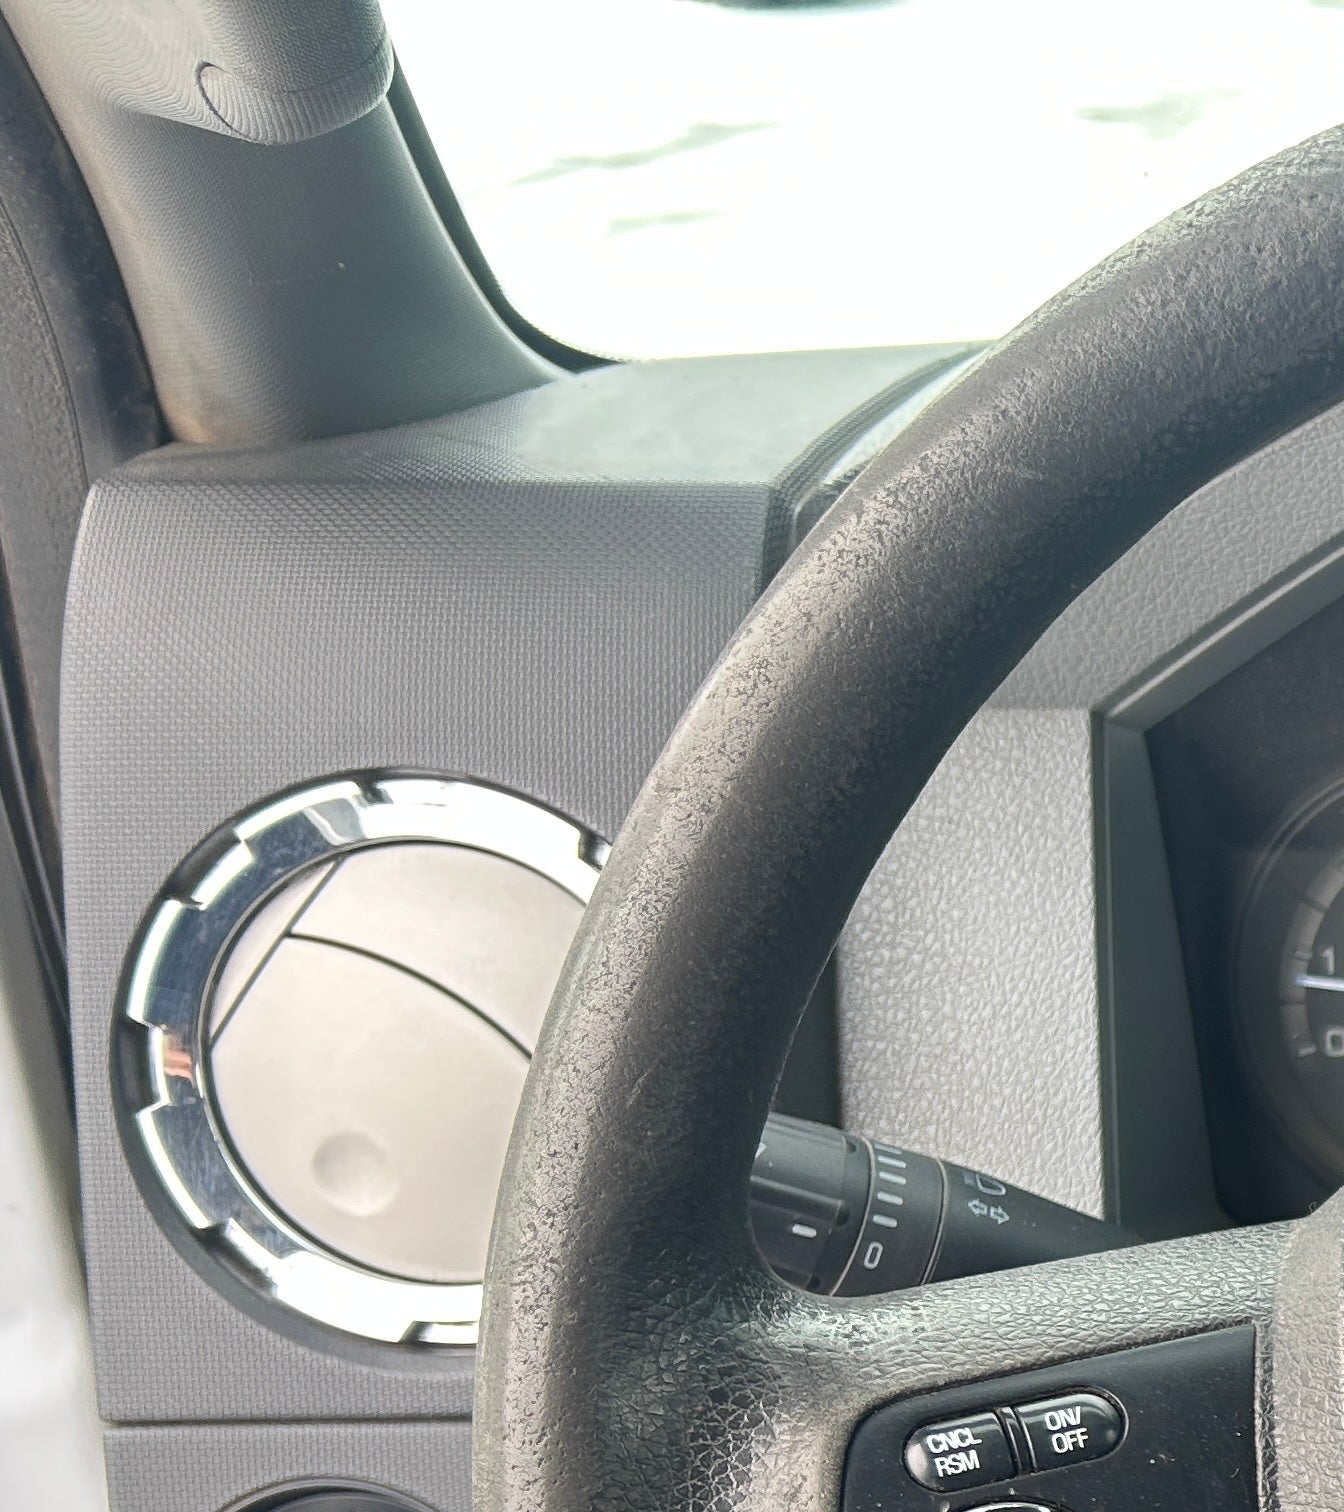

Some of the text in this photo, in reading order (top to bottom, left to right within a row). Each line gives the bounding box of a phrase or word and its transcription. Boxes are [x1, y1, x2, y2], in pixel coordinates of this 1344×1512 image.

[1320, 946, 1336, 976] 1
[1044, 1406, 1082, 1431] ON/
[926, 1428, 982, 1454] CNCL
[1051, 1429, 1089, 1454] OFF
[934, 1451, 980, 1477] RSM
